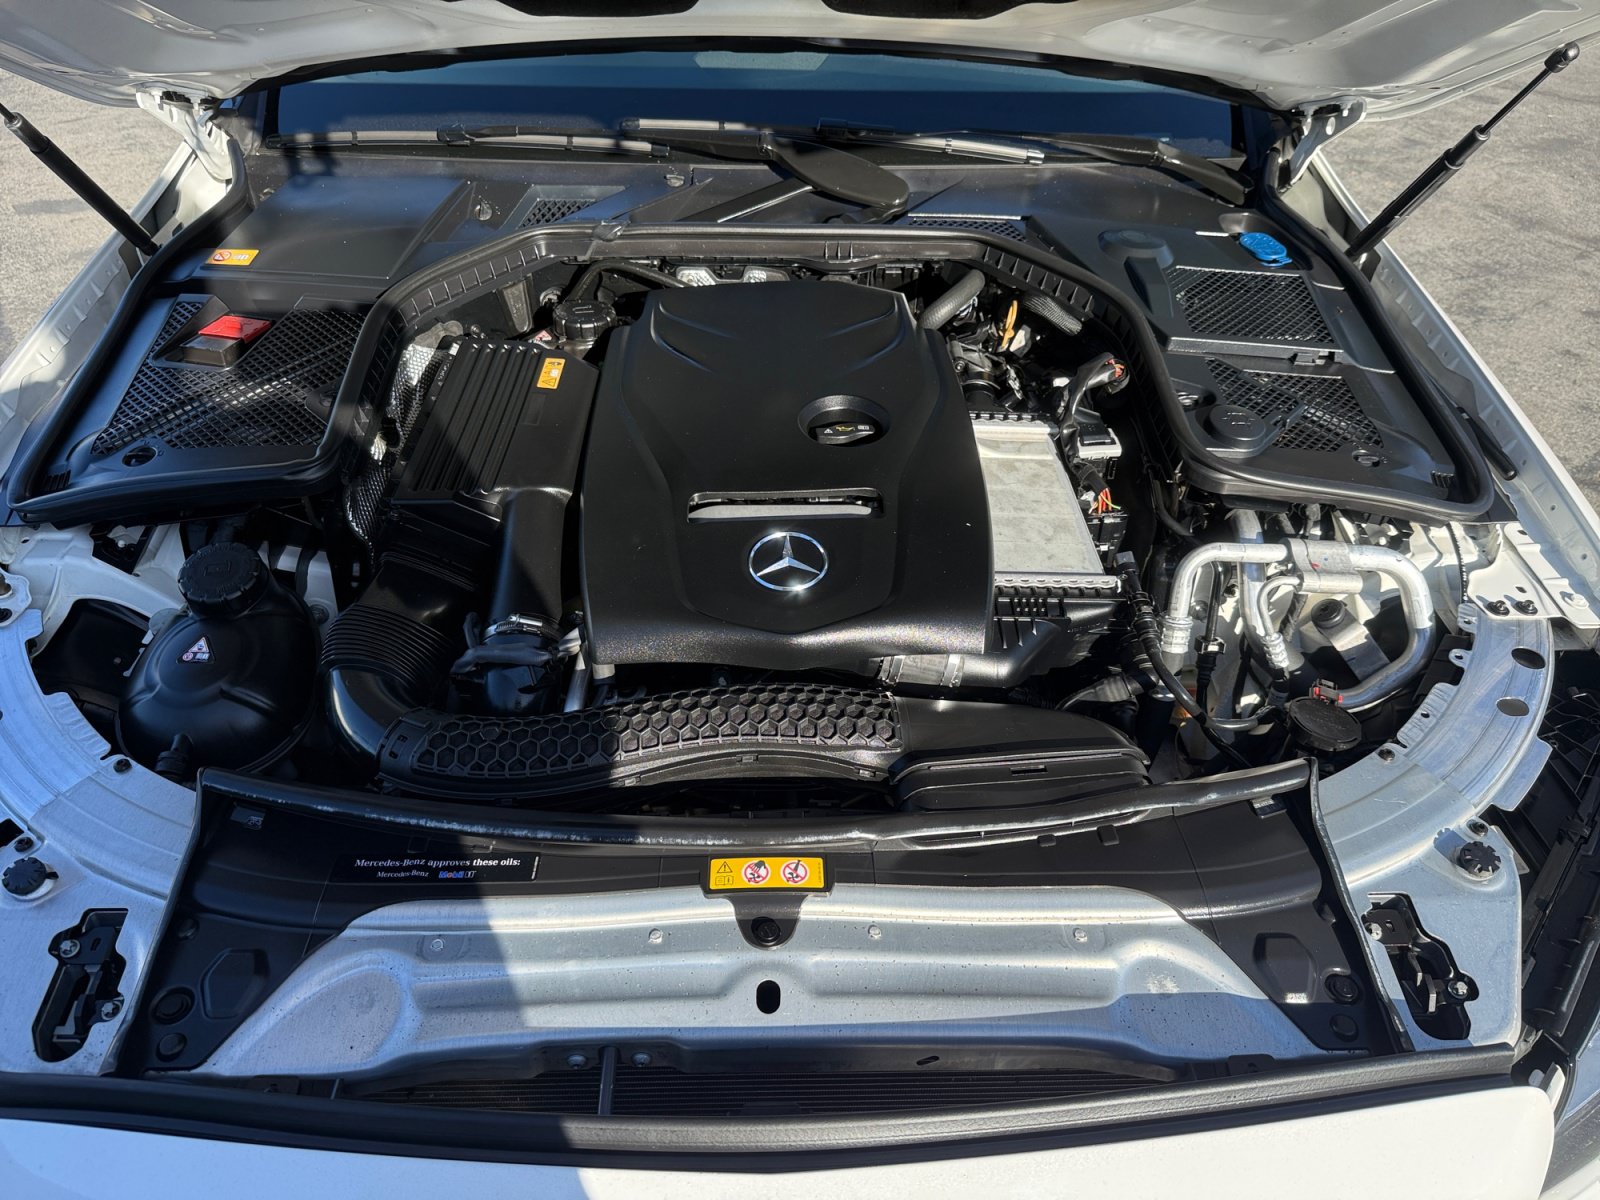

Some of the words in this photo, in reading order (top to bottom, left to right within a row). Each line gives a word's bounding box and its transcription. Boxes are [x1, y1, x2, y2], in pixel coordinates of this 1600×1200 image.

[354, 859, 426, 867] Mercedes-Benz
[428, 860, 471, 868] approves
[473, 858, 499, 866] these
[500, 857, 521, 866] oils:
[376, 870, 430, 878] Mercedes-Benz
